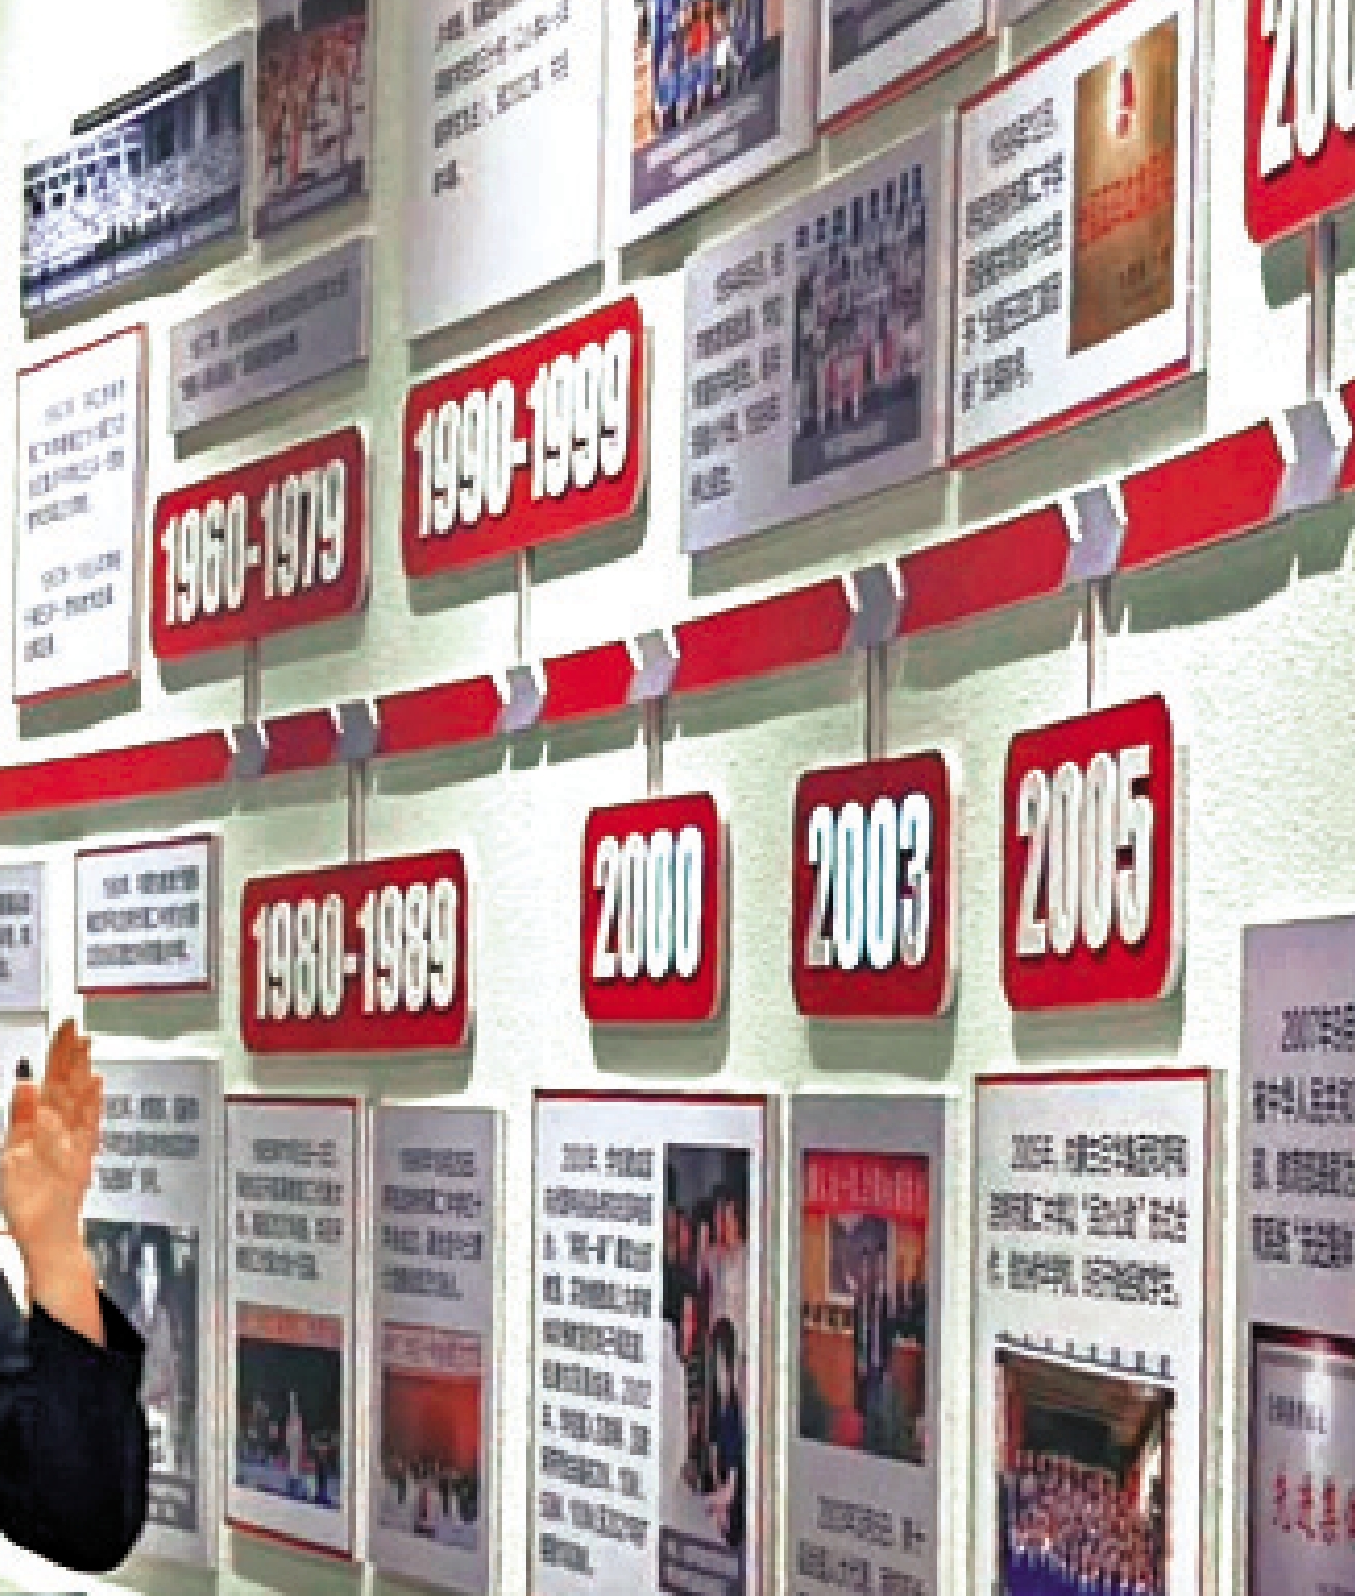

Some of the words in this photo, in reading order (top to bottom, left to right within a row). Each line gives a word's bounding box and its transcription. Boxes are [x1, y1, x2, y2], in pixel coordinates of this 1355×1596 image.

[414, 329, 631, 538] 1990-1999
[161, 458, 345, 627] 1960-1979
[592, 824, 704, 983] 2000
[806, 792, 931, 970] 2003
[1015, 745, 1155, 957] 2005
[251, 878, 458, 1020] 1980-1989
